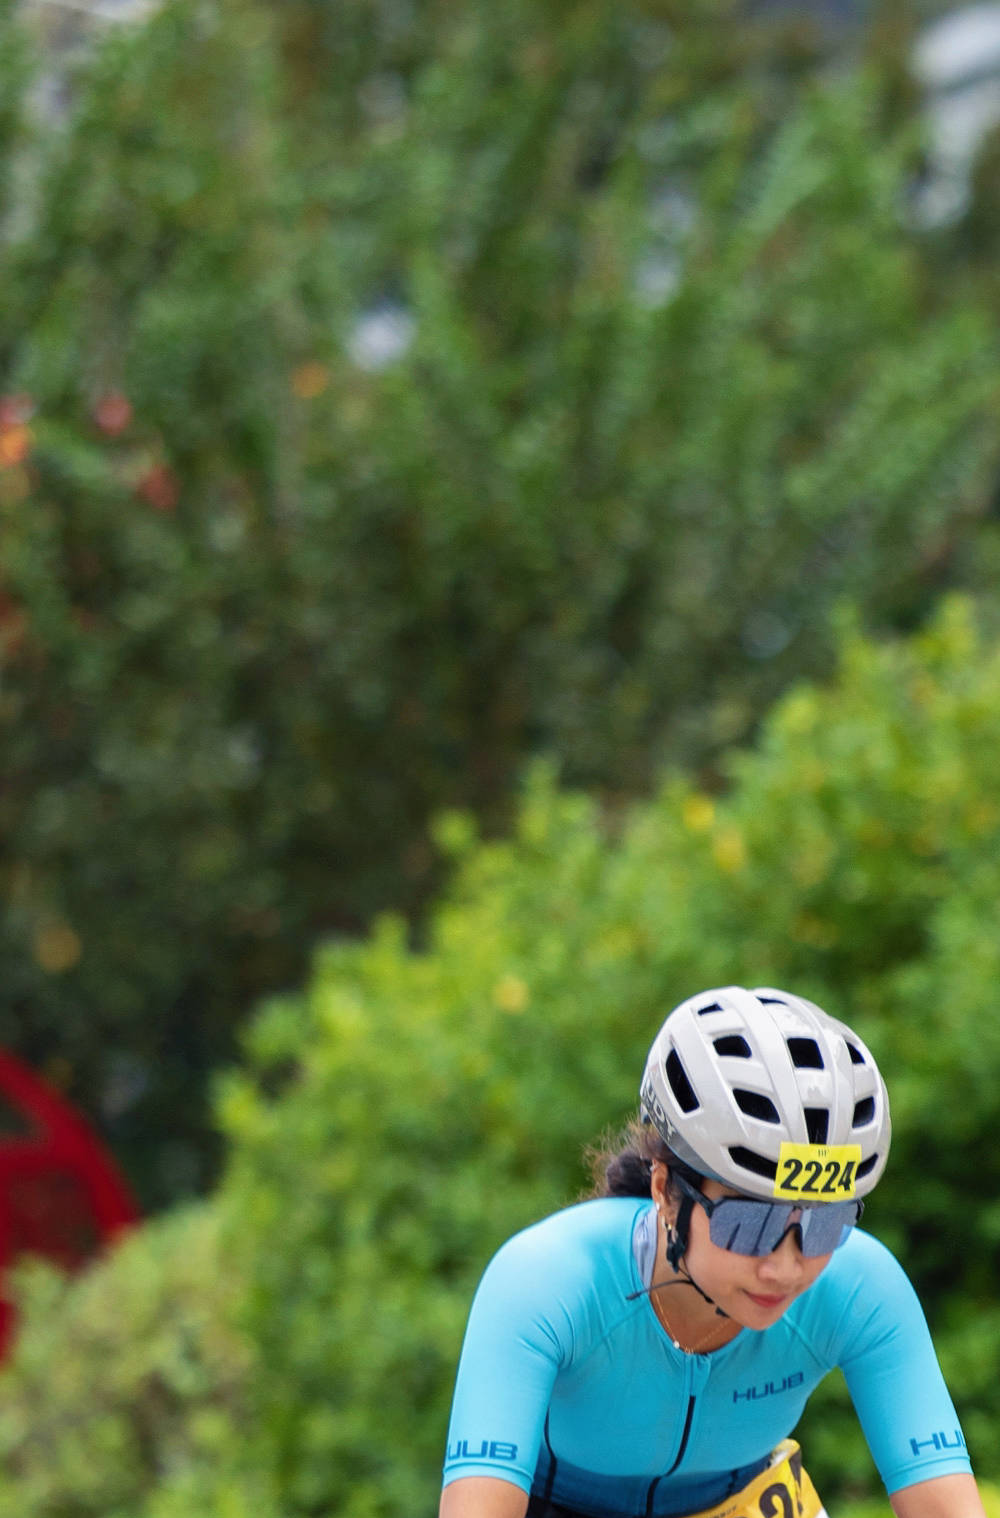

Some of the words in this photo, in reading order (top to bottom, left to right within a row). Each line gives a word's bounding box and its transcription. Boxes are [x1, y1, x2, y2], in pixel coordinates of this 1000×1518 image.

[779, 1158, 857, 1193] 2224
[732, 1371, 804, 1403] HUUB
[909, 1429, 967, 1456] HU
